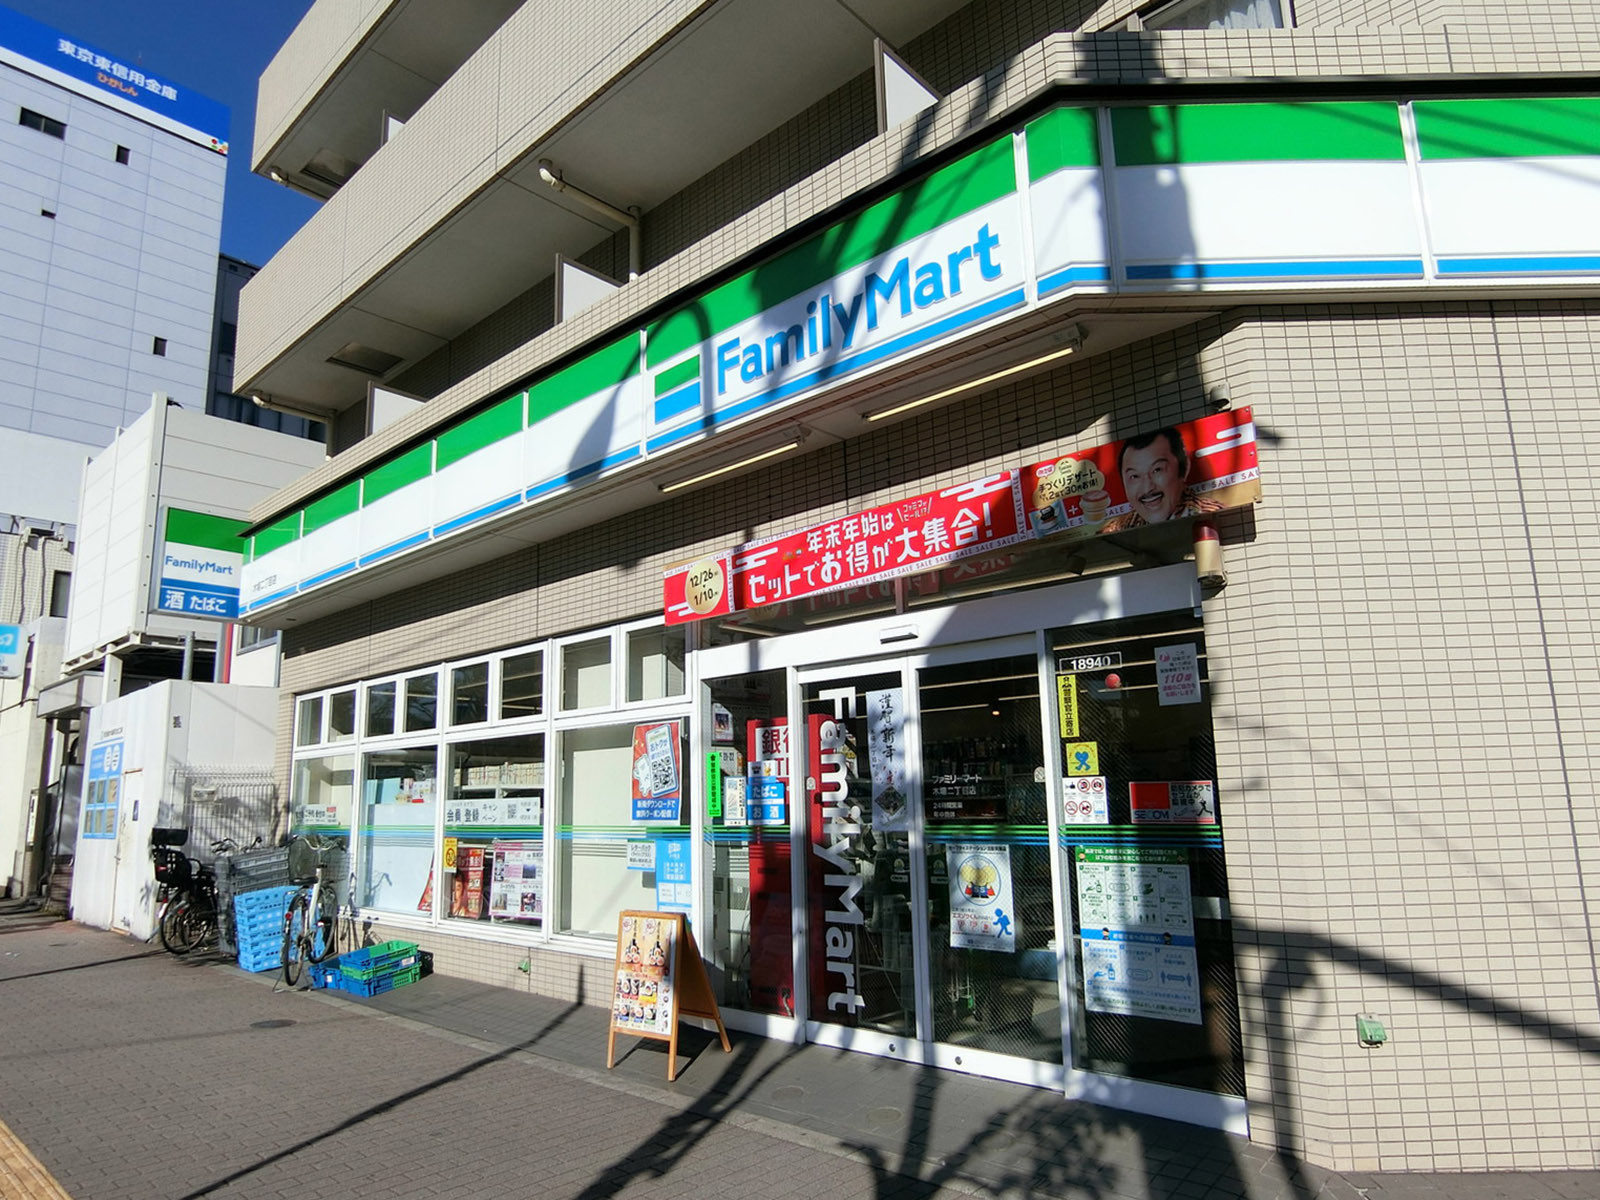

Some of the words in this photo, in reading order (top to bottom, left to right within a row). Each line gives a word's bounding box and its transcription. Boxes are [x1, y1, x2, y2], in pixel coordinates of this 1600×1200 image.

[57, 38, 178, 102] 東京東信用金庫
[96, 72, 138, 97] ひがしん
[716, 222, 1003, 396] FamilyMart
[1212, 475, 1236, 489] SALE
[806, 512, 895, 553] 年末年始は
[748, 501, 993, 604] セットでお得が大集合!
[879, 570, 894, 579] SALE
[897, 565, 913, 574] SALE
[915, 560, 932, 569] SALE
[935, 554, 953, 564] SALE
[955, 548, 973, 558] SALE
[976, 542, 993, 552] SALE
[996, 536, 1014, 546] SALE
[165, 555, 233, 575] FamilyMart
[690, 568, 714, 588] 12/26
[165, 589, 185, 609] 酒
[189, 595, 227, 613] たばこ
[694, 588, 714, 606] 1/10
[1071, 655, 1111, 671] 18940
[879, 694, 897, 762] 謹賀新年
[932, 774, 982, 784] ファミリーマート
[753, 785, 779, 798] たばこ
[1134, 810, 1169, 819] SEOM
[813, 686, 866, 1015] FamilyMart
